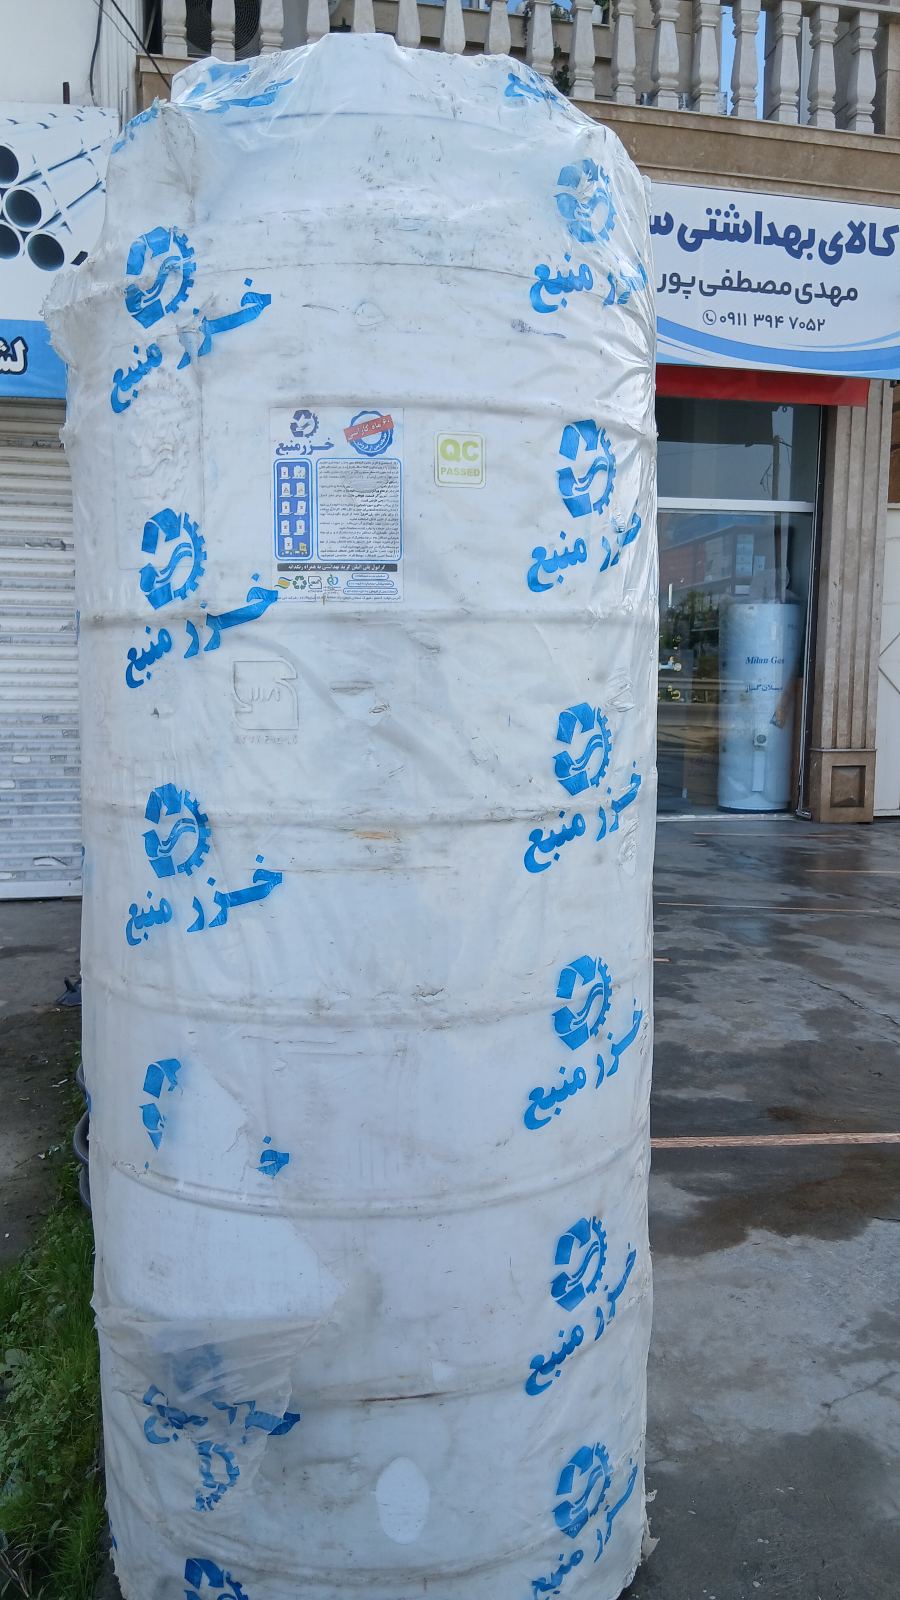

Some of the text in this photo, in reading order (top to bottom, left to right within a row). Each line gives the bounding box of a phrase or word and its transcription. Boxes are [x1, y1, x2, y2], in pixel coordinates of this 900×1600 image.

[677, 203, 816, 260] بهداشتی
[818, 219, 900, 265] کالای
[529, 252, 594, 314] منبع
[657, 269, 859, 307] مهدی مصطفی پور
[719, 312, 748, 327] ۰۹۱۱
[753, 314, 784, 329] ۳۹۴
[110, 342, 163, 414] منبع
[439, 438, 480, 462] QC
[440, 467, 481, 477] PASSED
[526, 530, 588, 593] منبع
[125, 572, 279, 689] خزر منبع
[524, 760, 642, 874] خزر منبع
[125, 854, 283, 946] خزر منبع
[524, 998, 643, 1131] خزر منبع
[525, 1242, 637, 1396] خزر منبع
[593, 1457, 638, 1563] خزر
